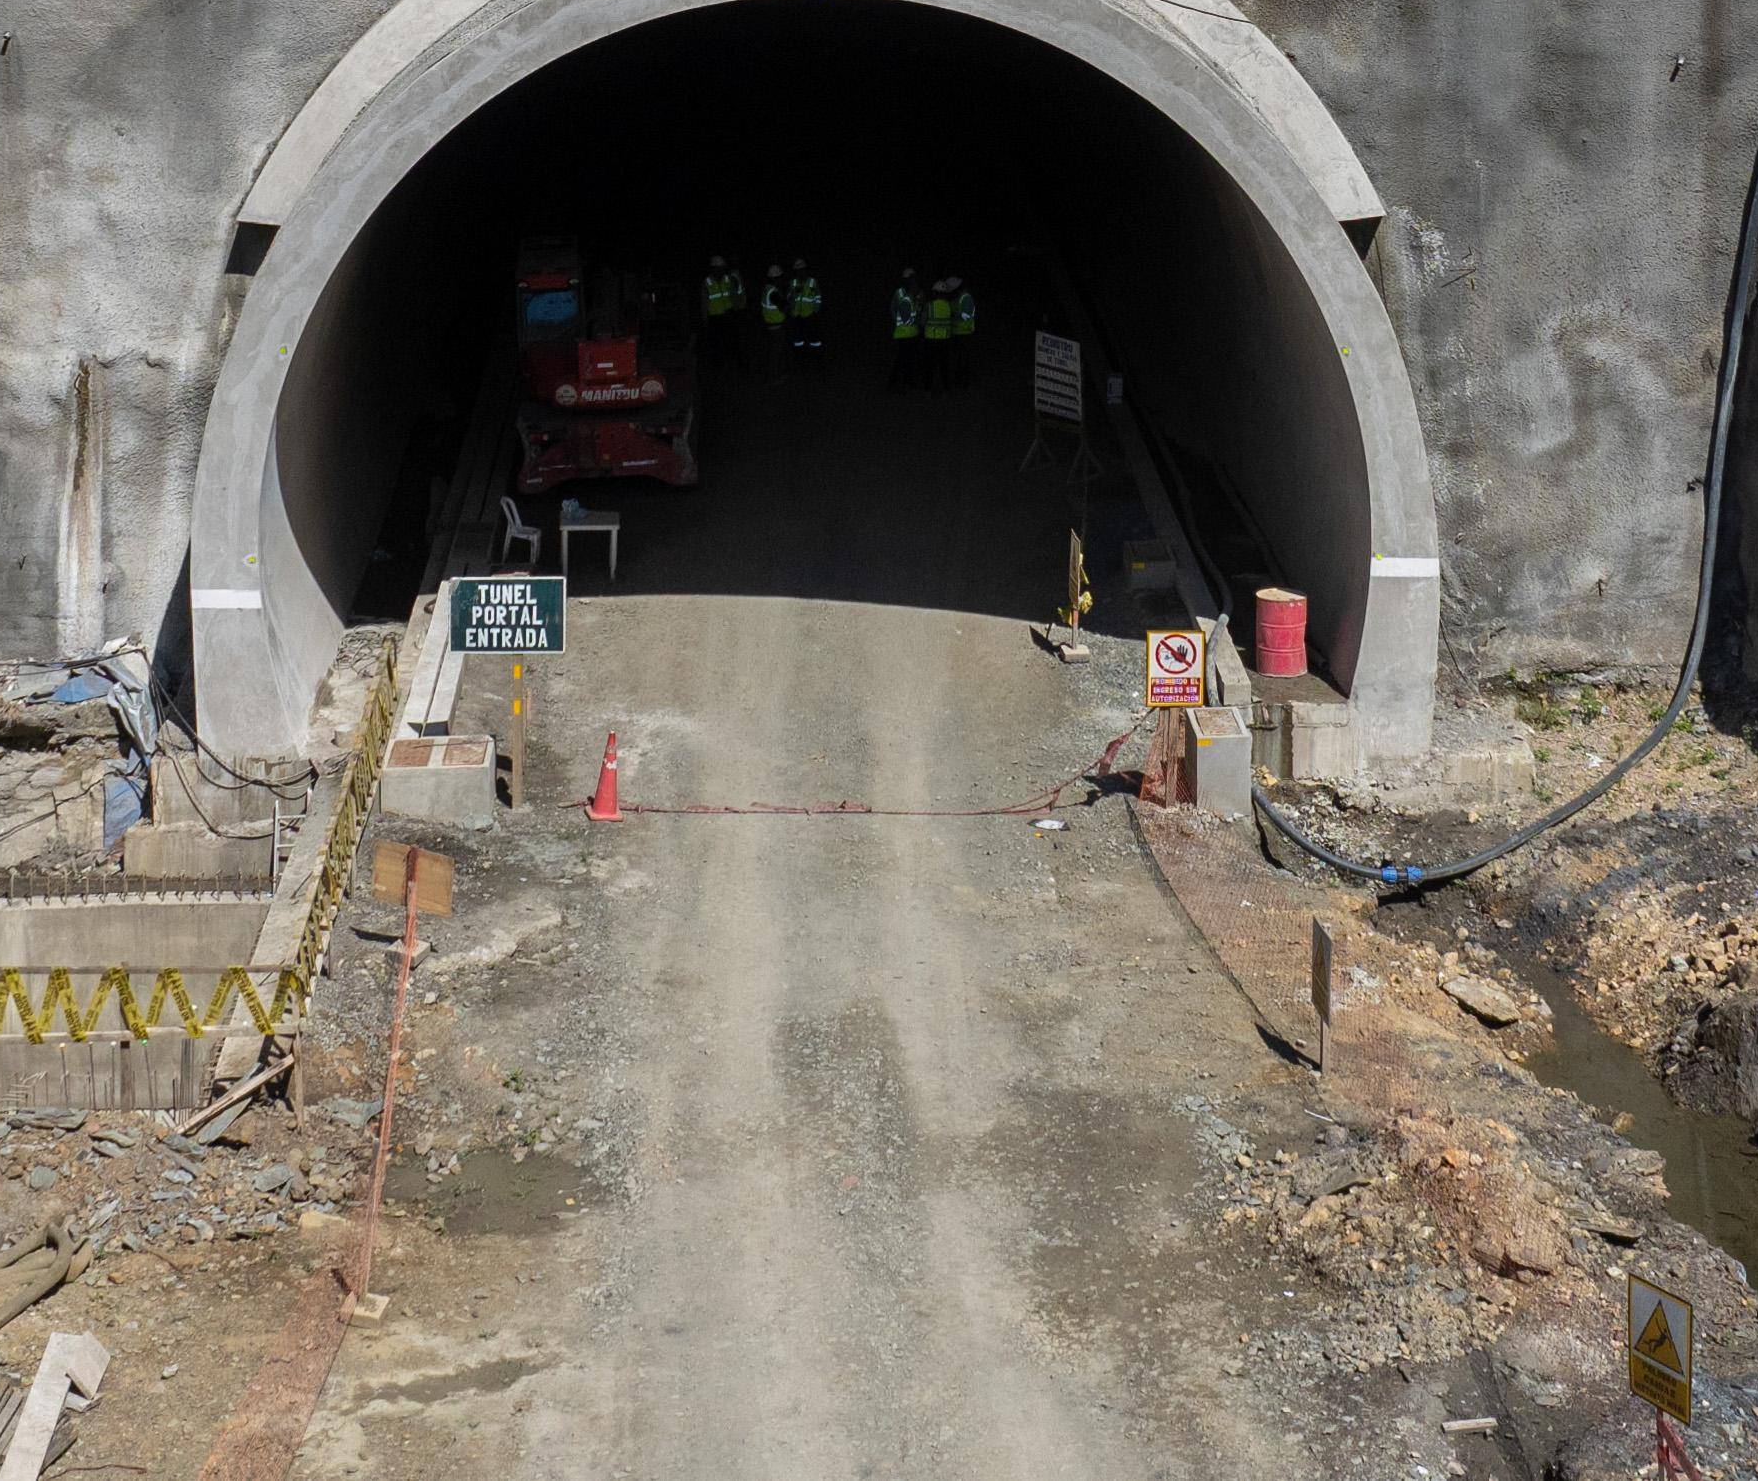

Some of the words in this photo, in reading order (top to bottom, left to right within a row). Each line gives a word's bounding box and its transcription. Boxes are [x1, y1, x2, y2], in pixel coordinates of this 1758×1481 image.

[478, 584, 537, 605] TUNEL
[472, 605, 543, 626] PORTAL
[465, 628, 548, 648] ENTRADA
